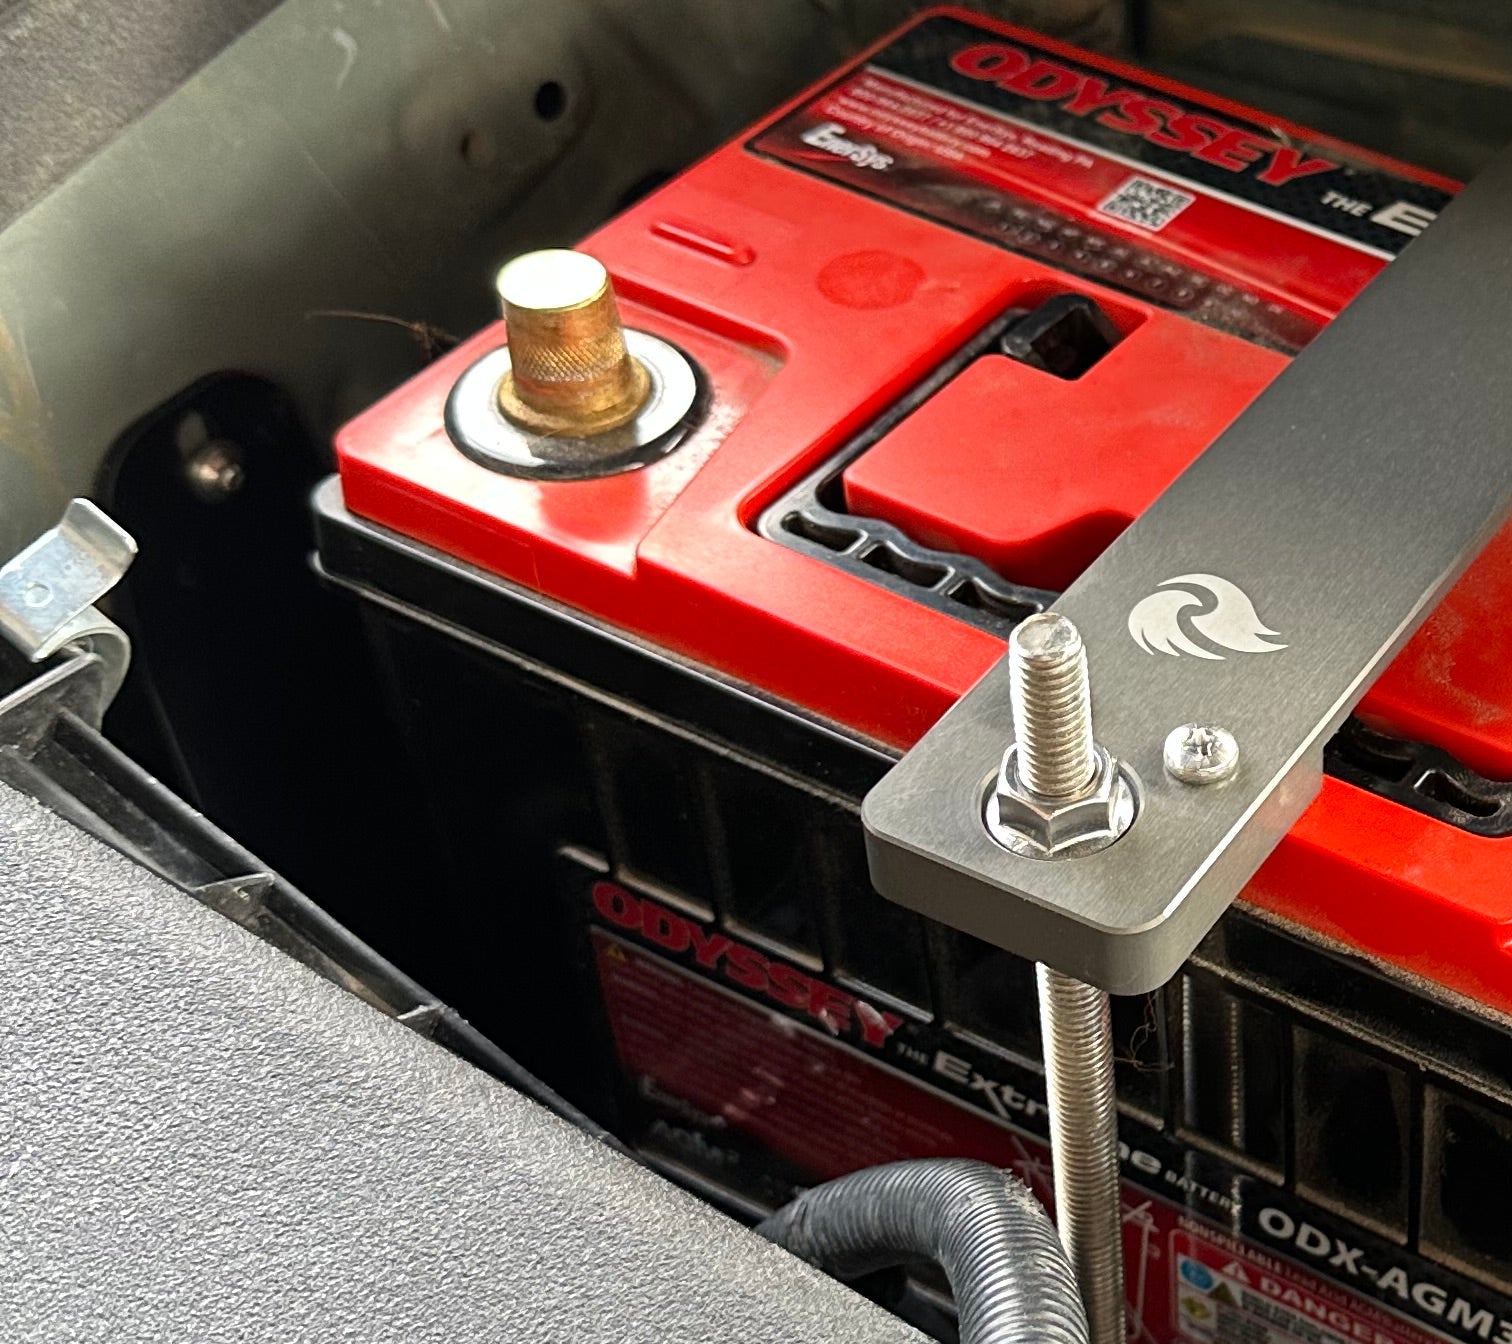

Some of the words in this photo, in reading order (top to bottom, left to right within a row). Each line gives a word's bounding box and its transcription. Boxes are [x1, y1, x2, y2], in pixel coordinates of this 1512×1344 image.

[949, 42, 1340, 188] ODYSSEY
[1320, 189, 1374, 218] THE
[592, 880, 905, 1049] ODYSSEY
